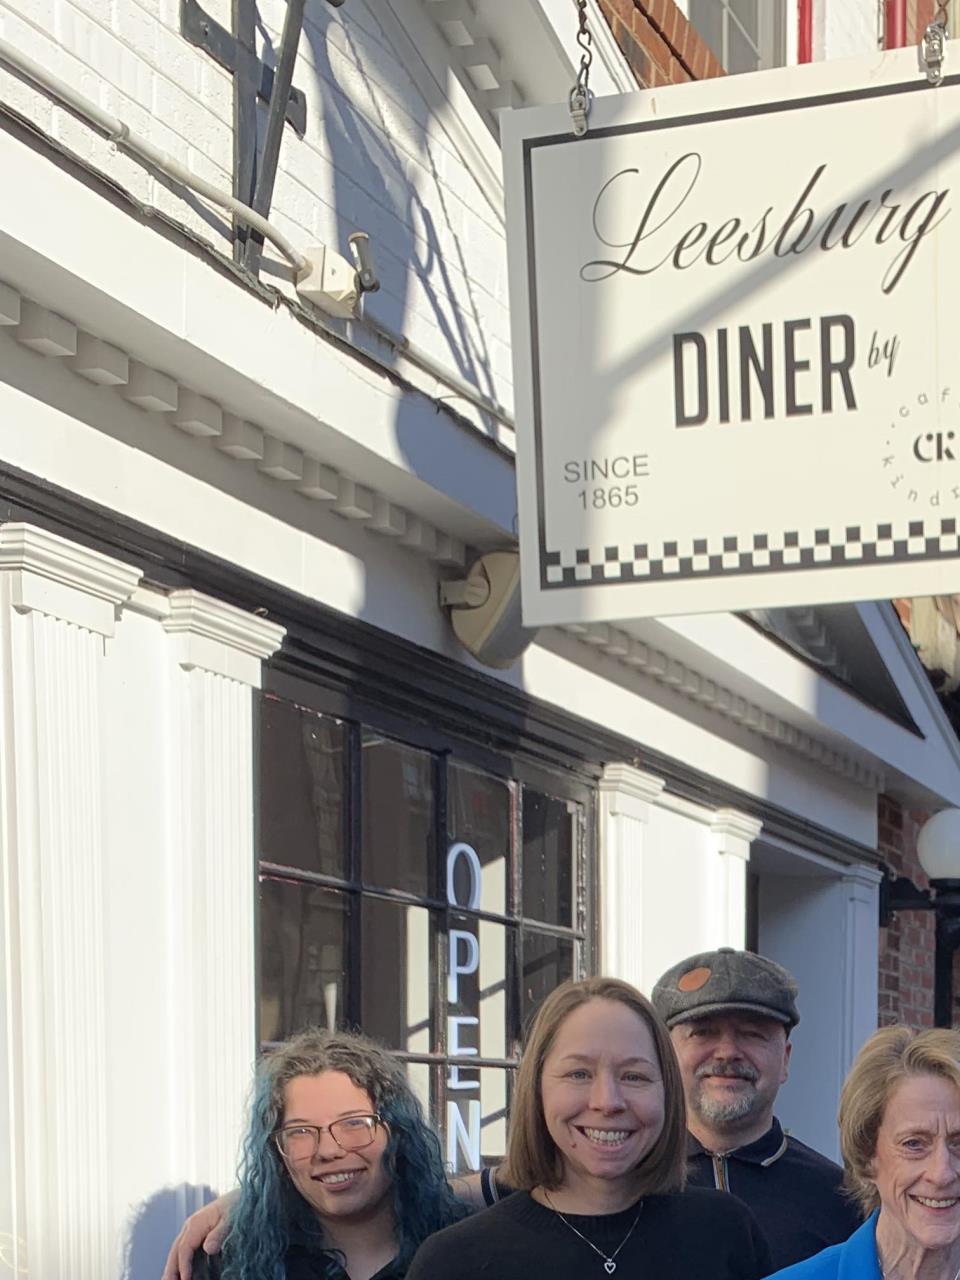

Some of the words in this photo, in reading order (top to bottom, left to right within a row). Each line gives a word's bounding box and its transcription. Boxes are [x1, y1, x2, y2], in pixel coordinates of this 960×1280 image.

[579, 151, 952, 295] Leesburg
[671, 313, 858, 429] DINER
[867, 331, 901, 377] by
[563, 454, 650, 483] SINCE
[578, 484, 639, 511] 1865
[446, 842, 482, 1173] OPEN
